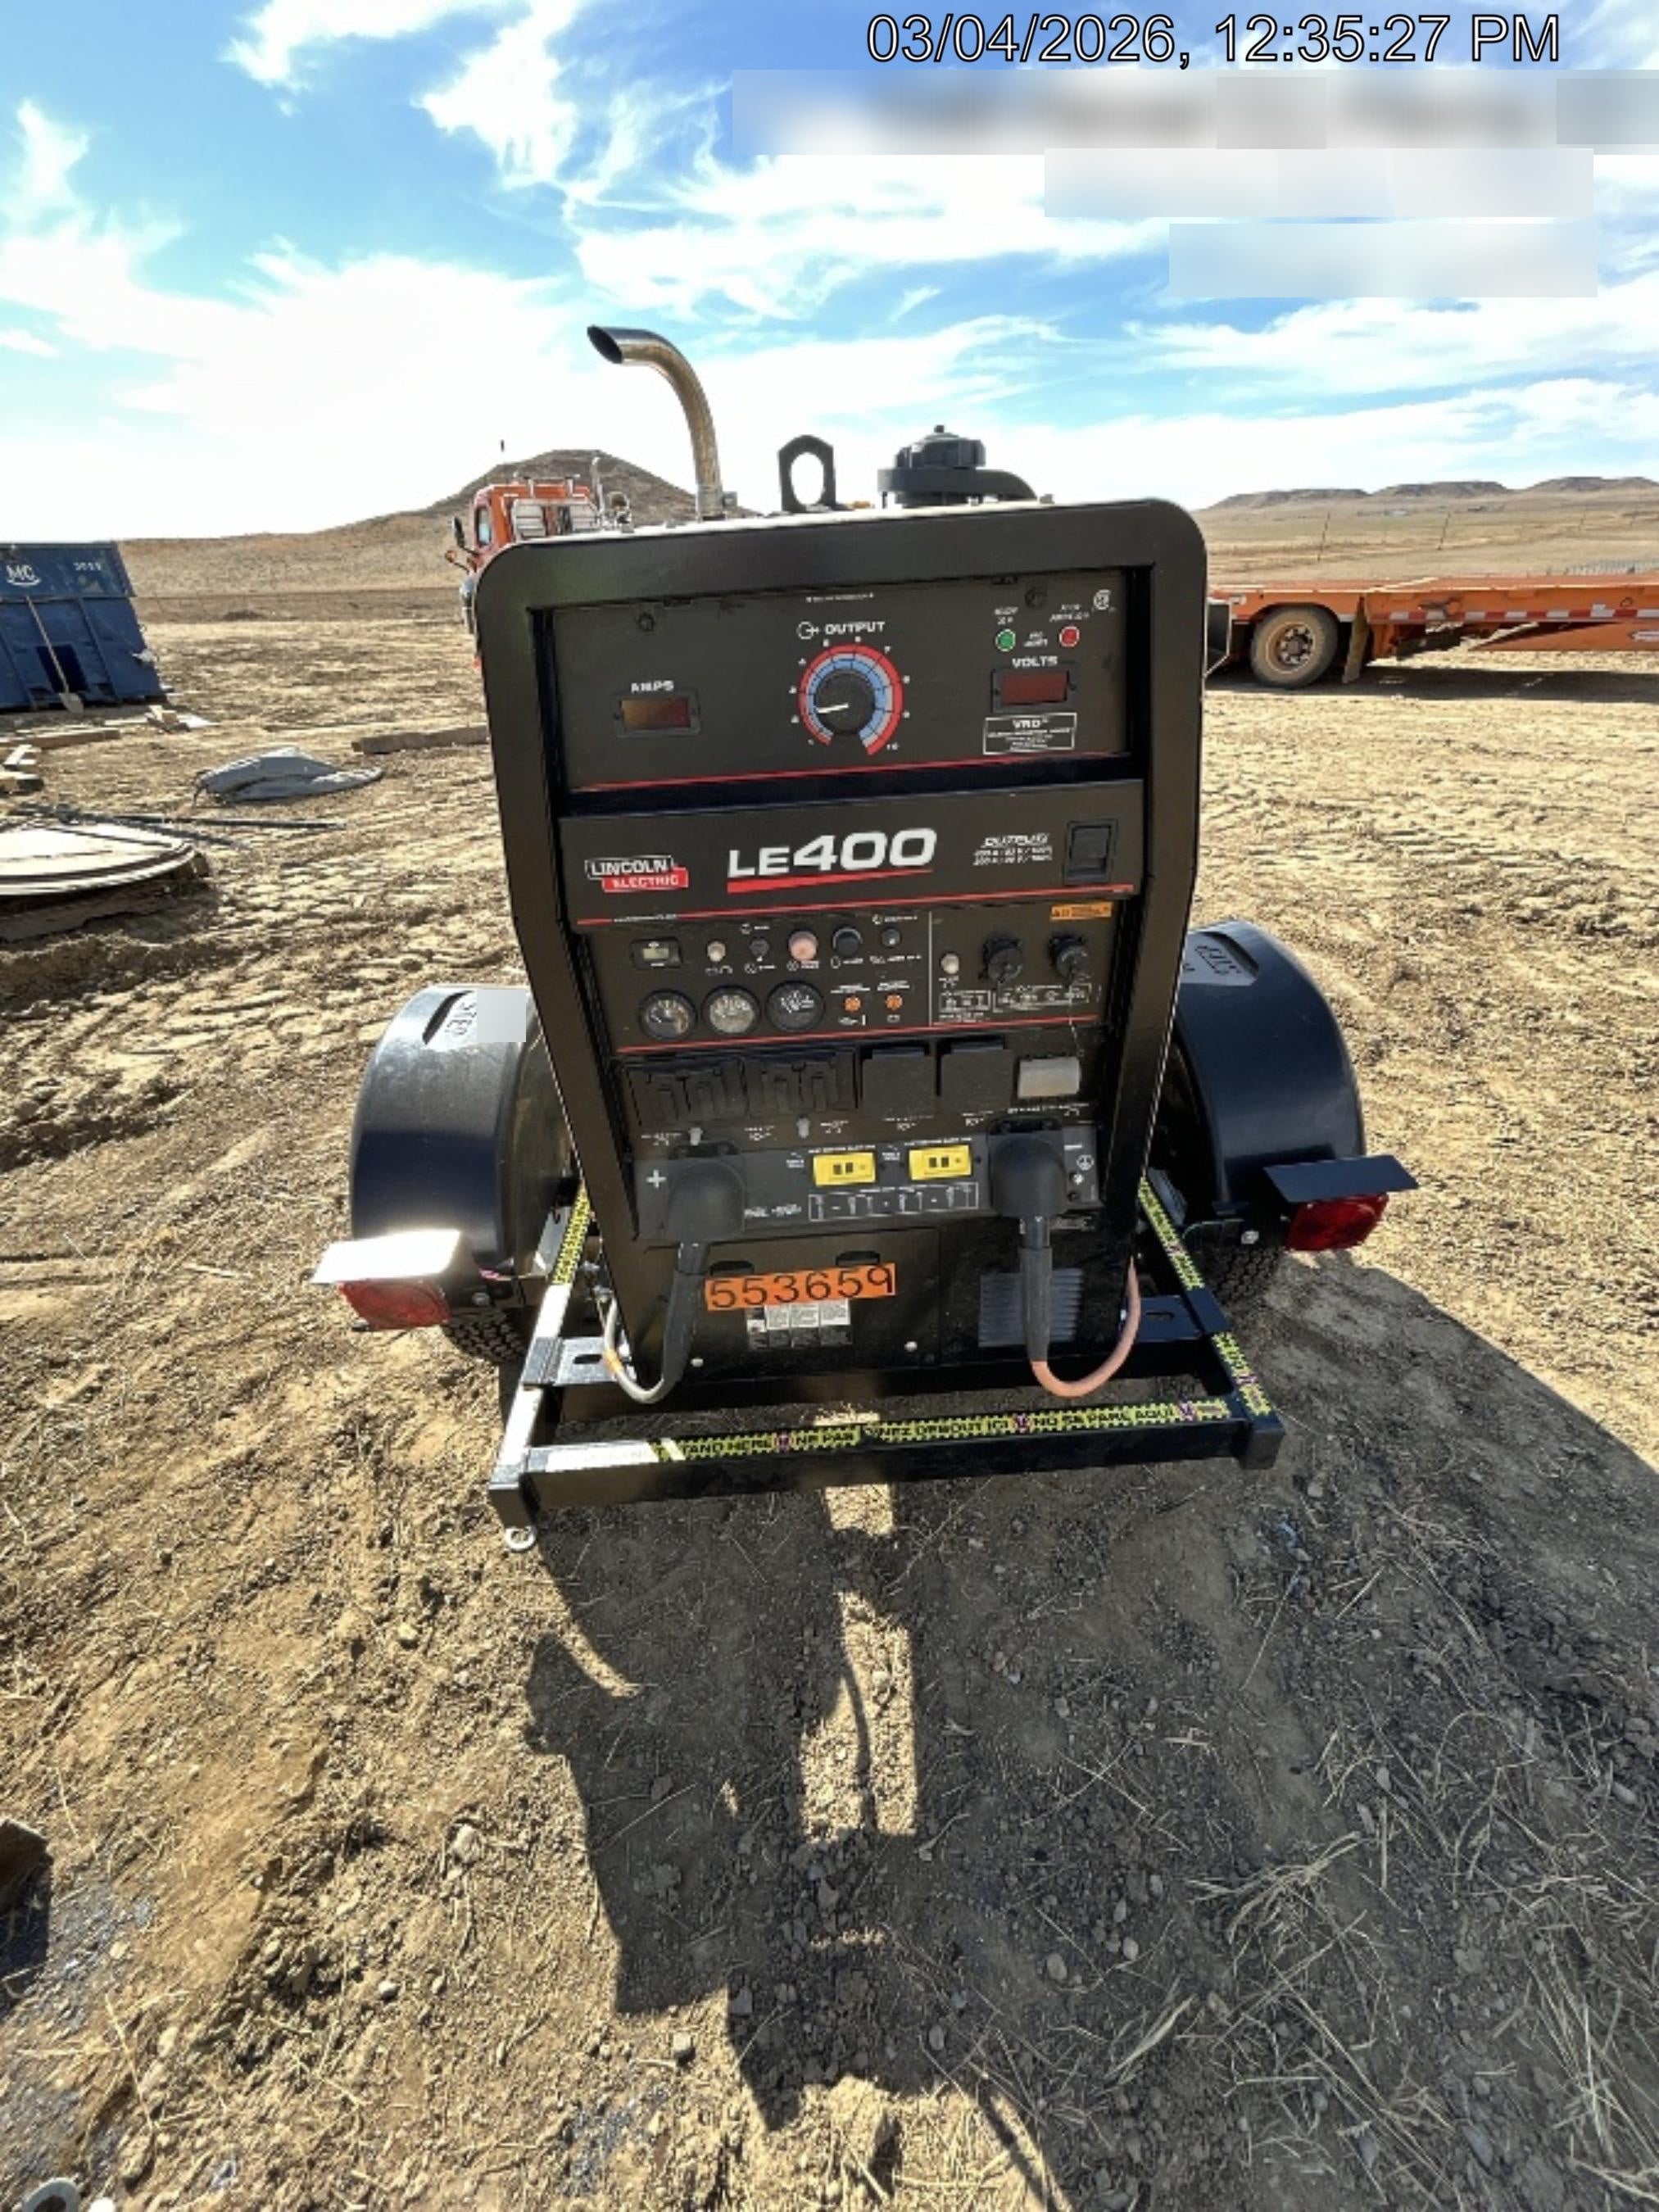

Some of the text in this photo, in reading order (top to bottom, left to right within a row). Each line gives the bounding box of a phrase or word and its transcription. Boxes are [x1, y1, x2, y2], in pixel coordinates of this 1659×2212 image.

[825, 621, 886, 635] OUTPUT
[1012, 655, 1058, 668] VOLTS
[631, 680, 674, 692] AMPS
[728, 827, 937, 878] LE400
[591, 857, 669, 876] LINCOLN
[611, 873, 679, 889] ELECTRIC
[709, 1267, 893, 1308] 553659
